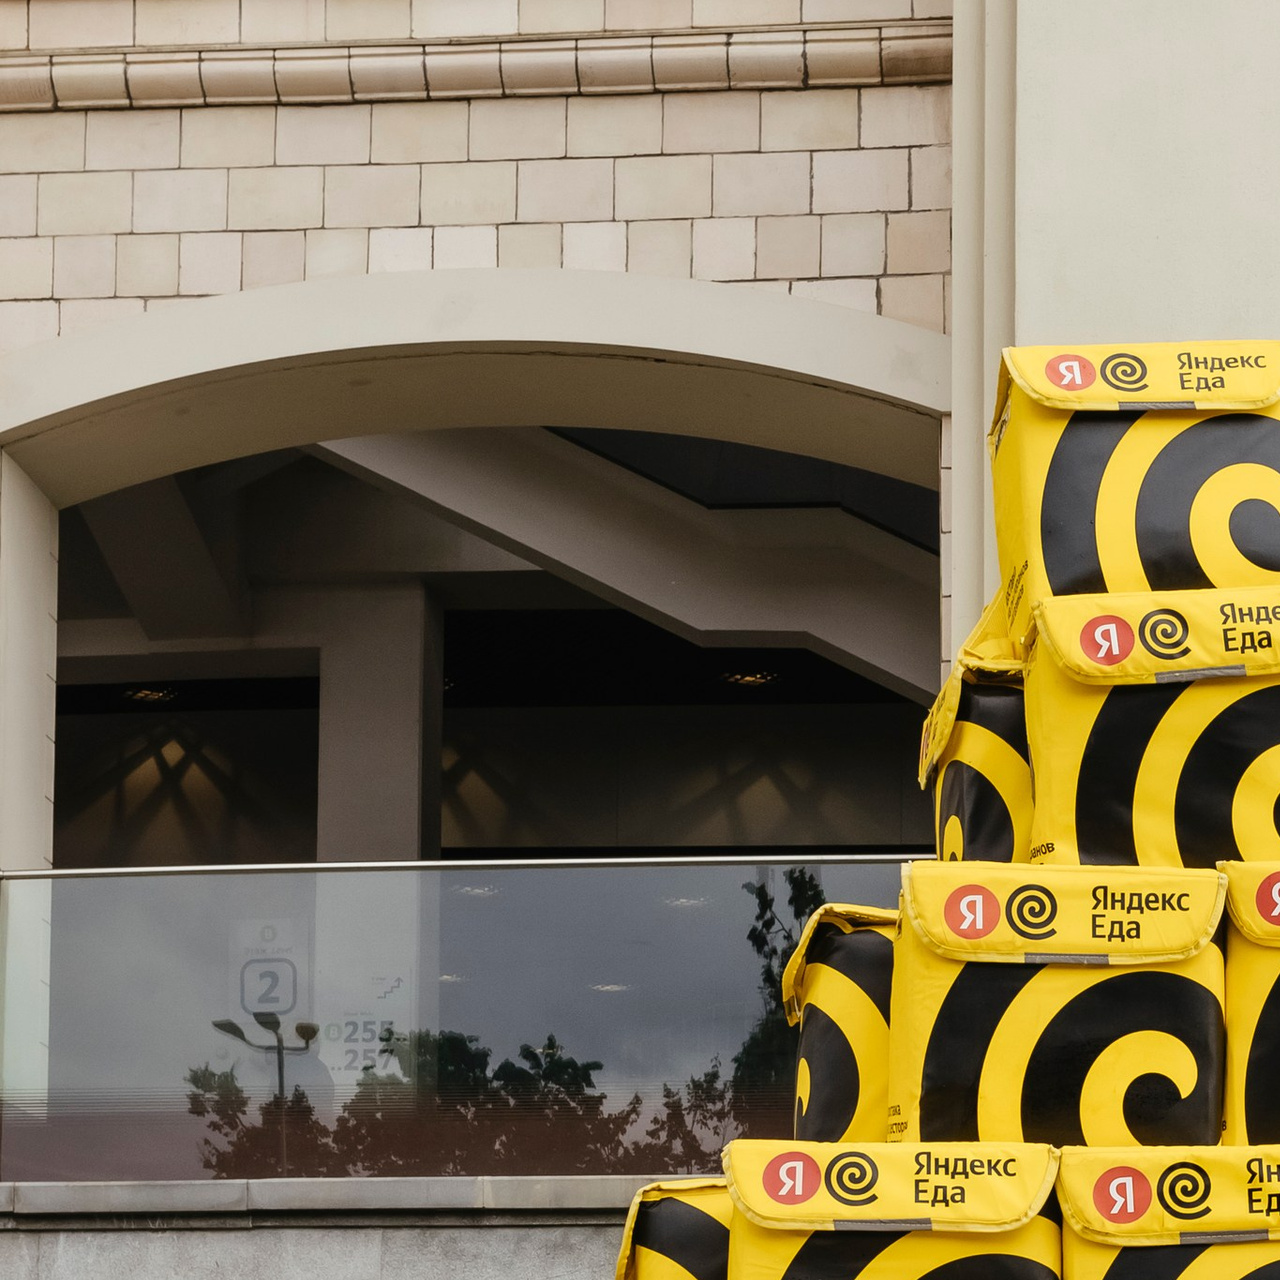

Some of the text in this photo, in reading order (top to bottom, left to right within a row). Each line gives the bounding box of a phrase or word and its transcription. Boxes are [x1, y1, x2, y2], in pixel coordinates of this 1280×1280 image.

[1178, 353, 1265, 372] Яндекс
[1180, 373, 1224, 391] Еда
[1223, 628, 1272, 654] Еда
[1092, 886, 1189, 914] Яндекс
[1092, 914, 1140, 942] Еда
[258, 970, 280, 1004] 2
[915, 1152, 1016, 1179] Яндекс
[915, 1179, 965, 1207] Еда
